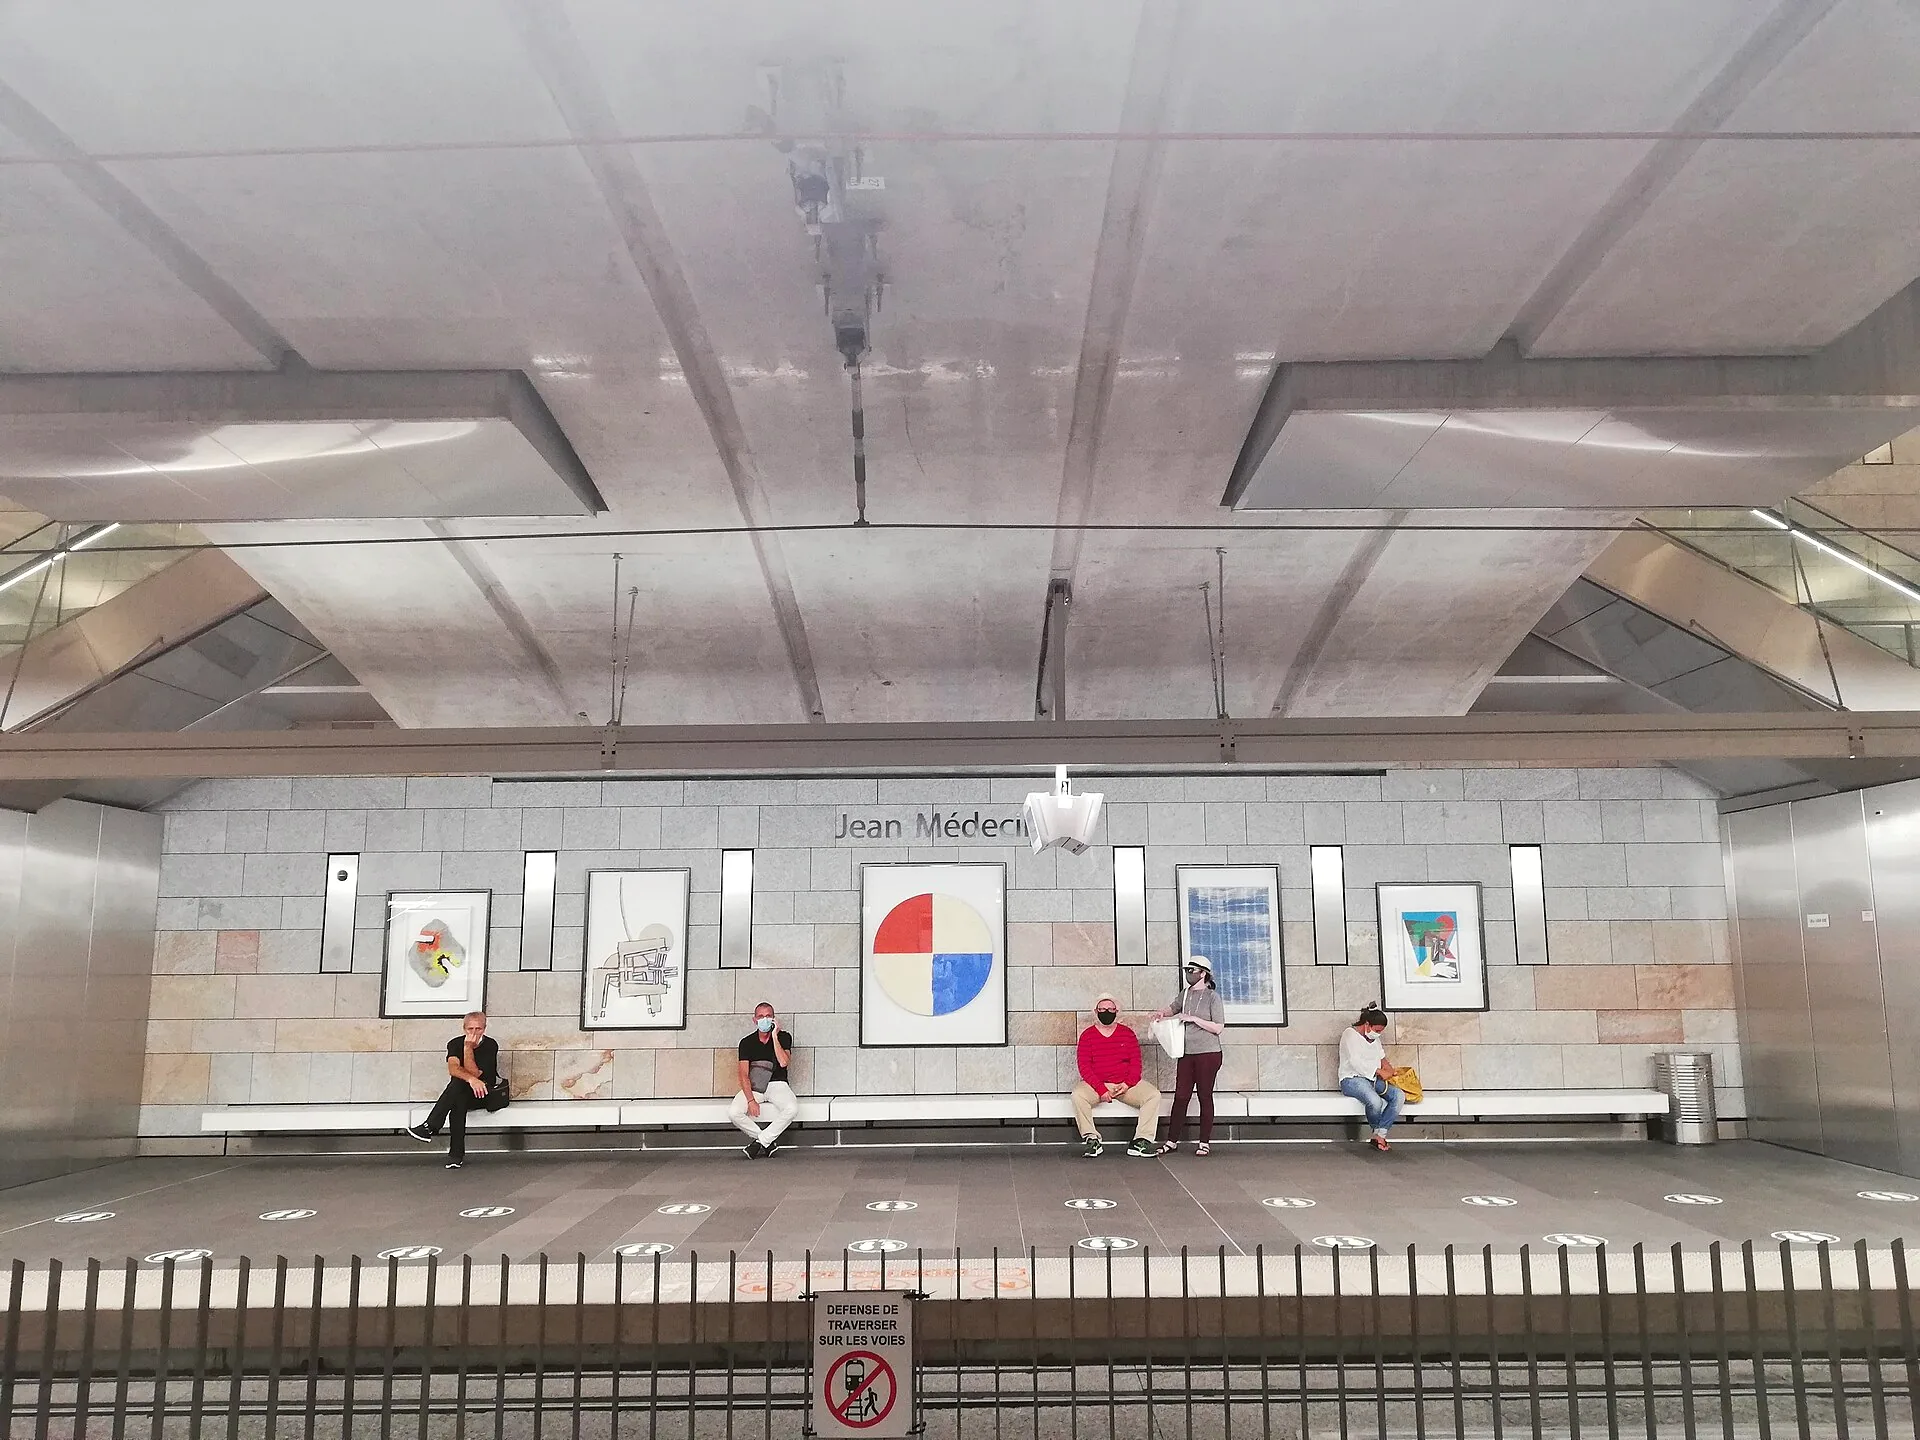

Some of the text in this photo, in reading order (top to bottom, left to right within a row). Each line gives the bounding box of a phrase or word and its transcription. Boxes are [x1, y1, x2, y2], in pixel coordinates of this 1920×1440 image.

[835, 813, 902, 839] Jean
[827, 1304, 899, 1315] DEFENSE DE
[828, 1320, 898, 1331] TRAVERSER
[819, 1335, 906, 1346] SUR LES VOIES
